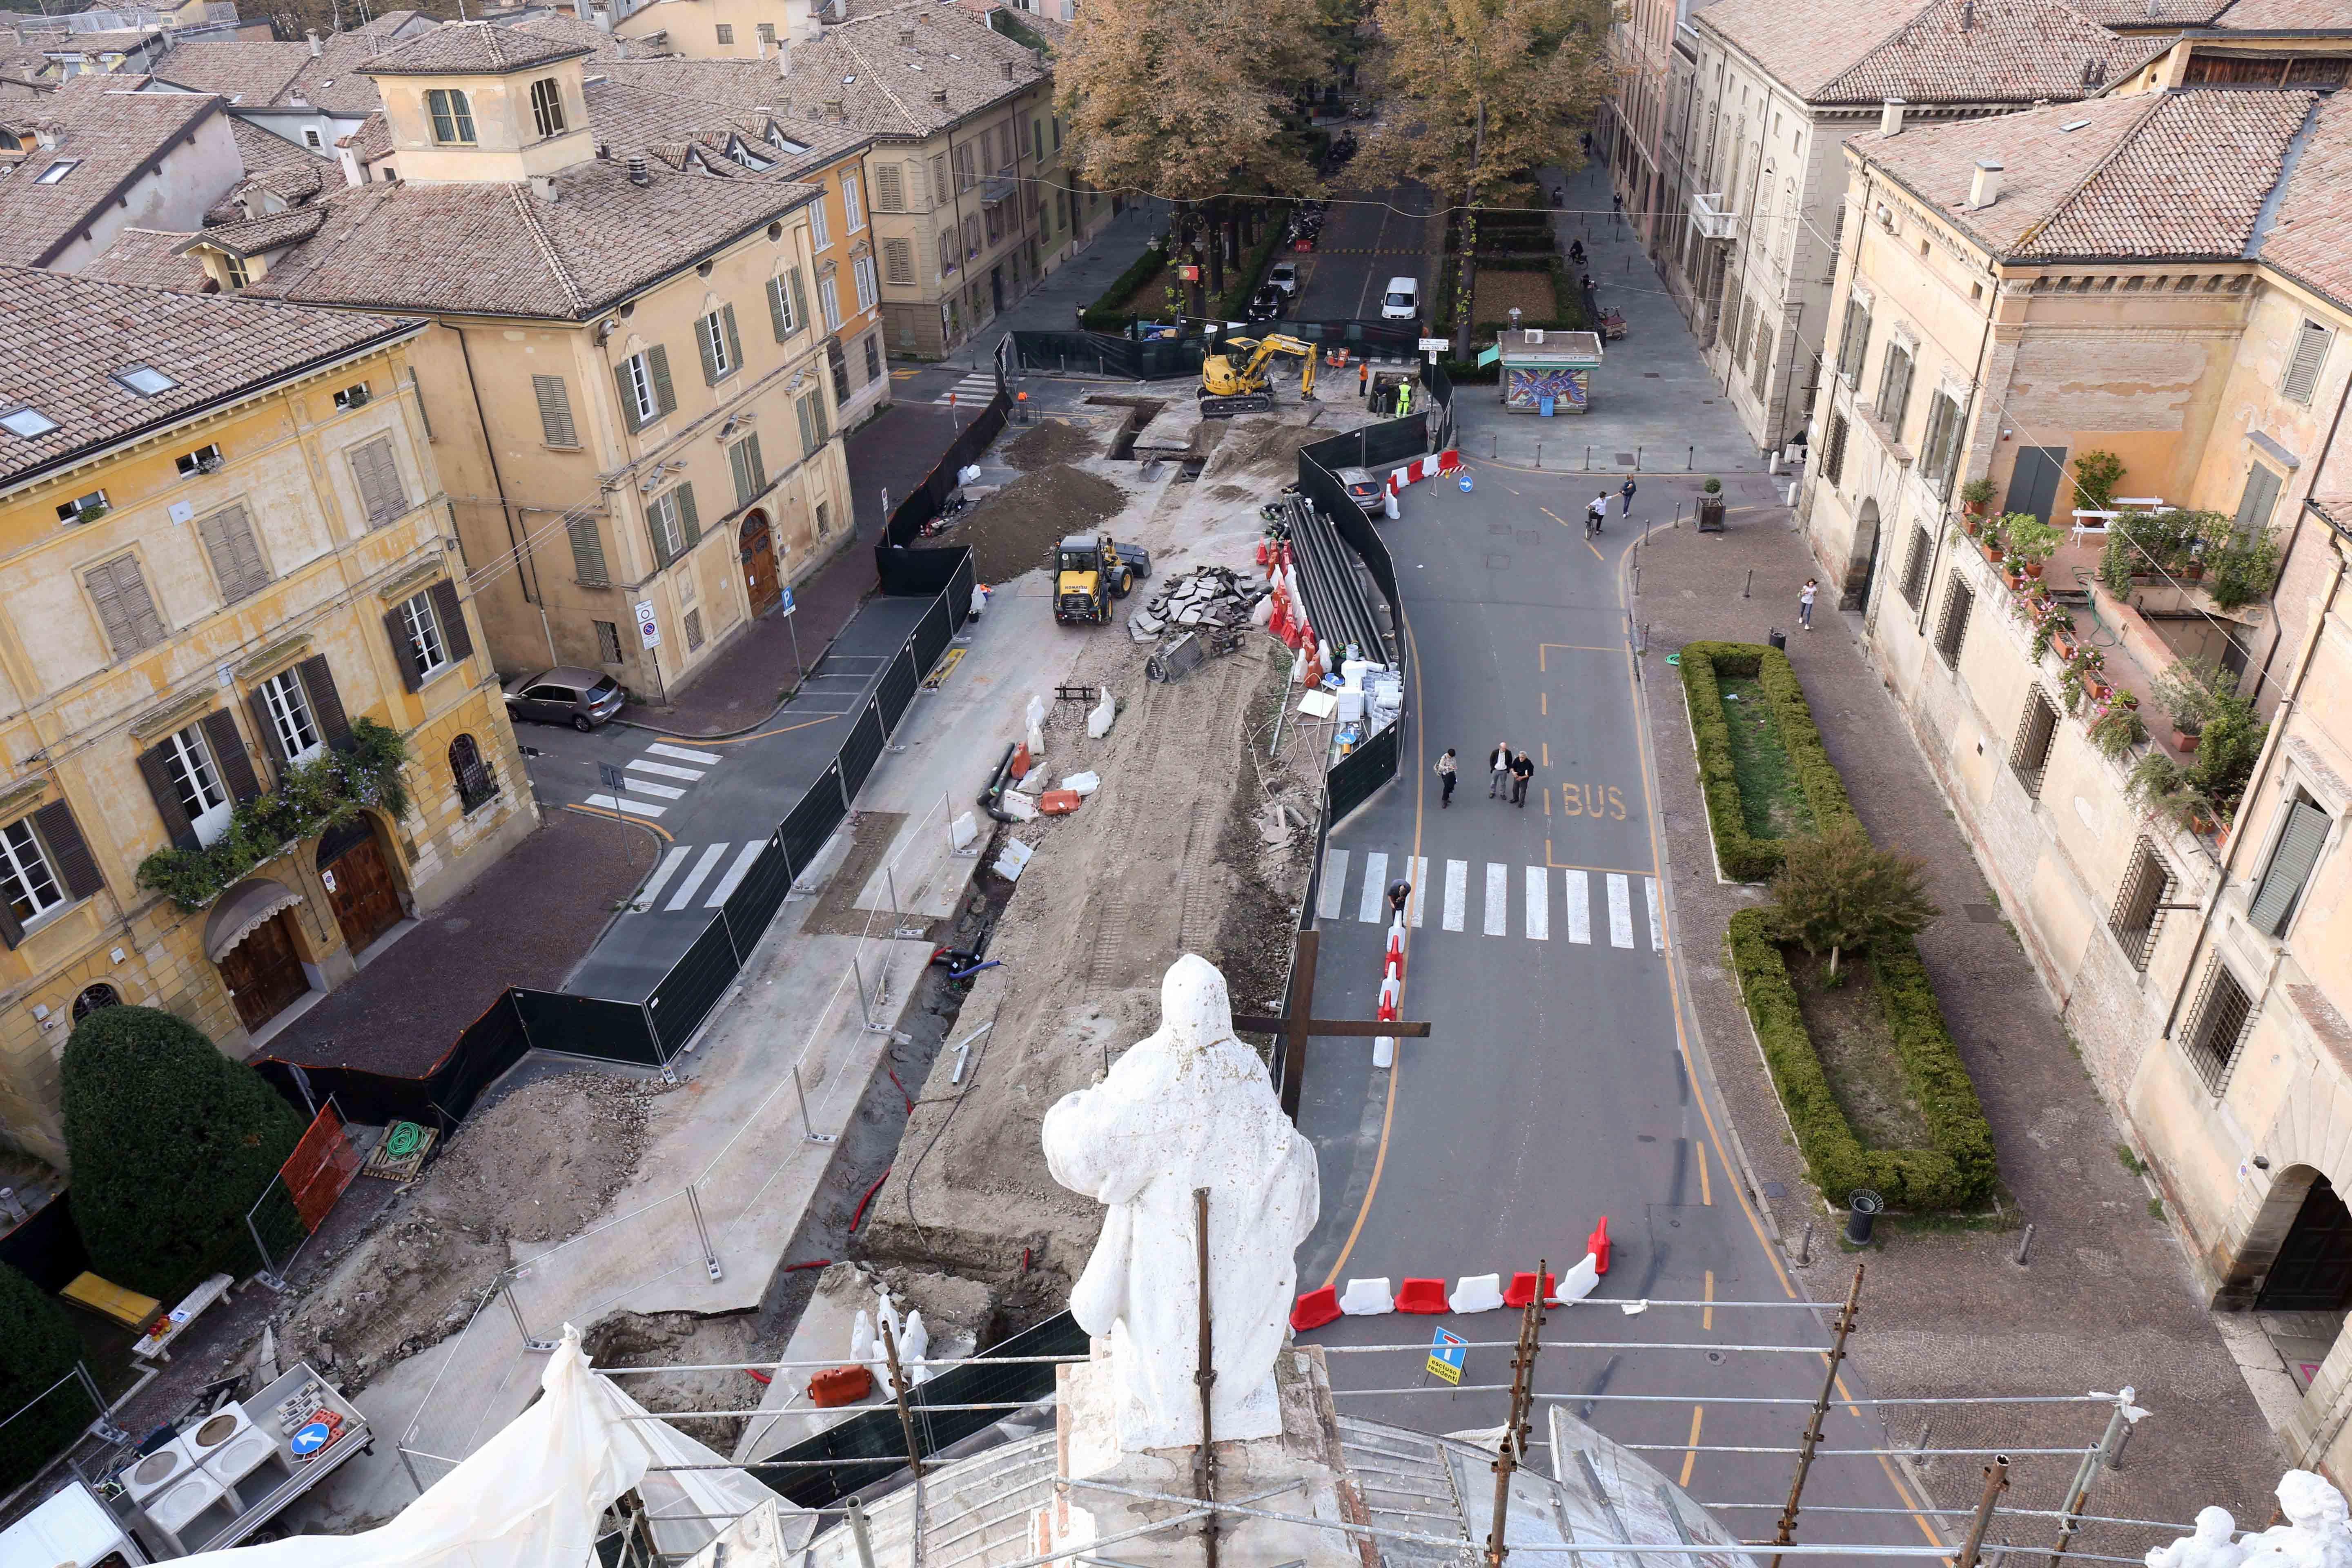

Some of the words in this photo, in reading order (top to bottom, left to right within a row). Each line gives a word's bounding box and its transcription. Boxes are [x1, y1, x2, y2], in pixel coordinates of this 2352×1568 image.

[784, 590, 790, 608] P
[1562, 782, 1627, 821] BUS
[241, 898, 293, 935] GIOIELLERIA
[1428, 1364, 1458, 1383] residenti
[1431, 1359, 1457, 1376] escluso
